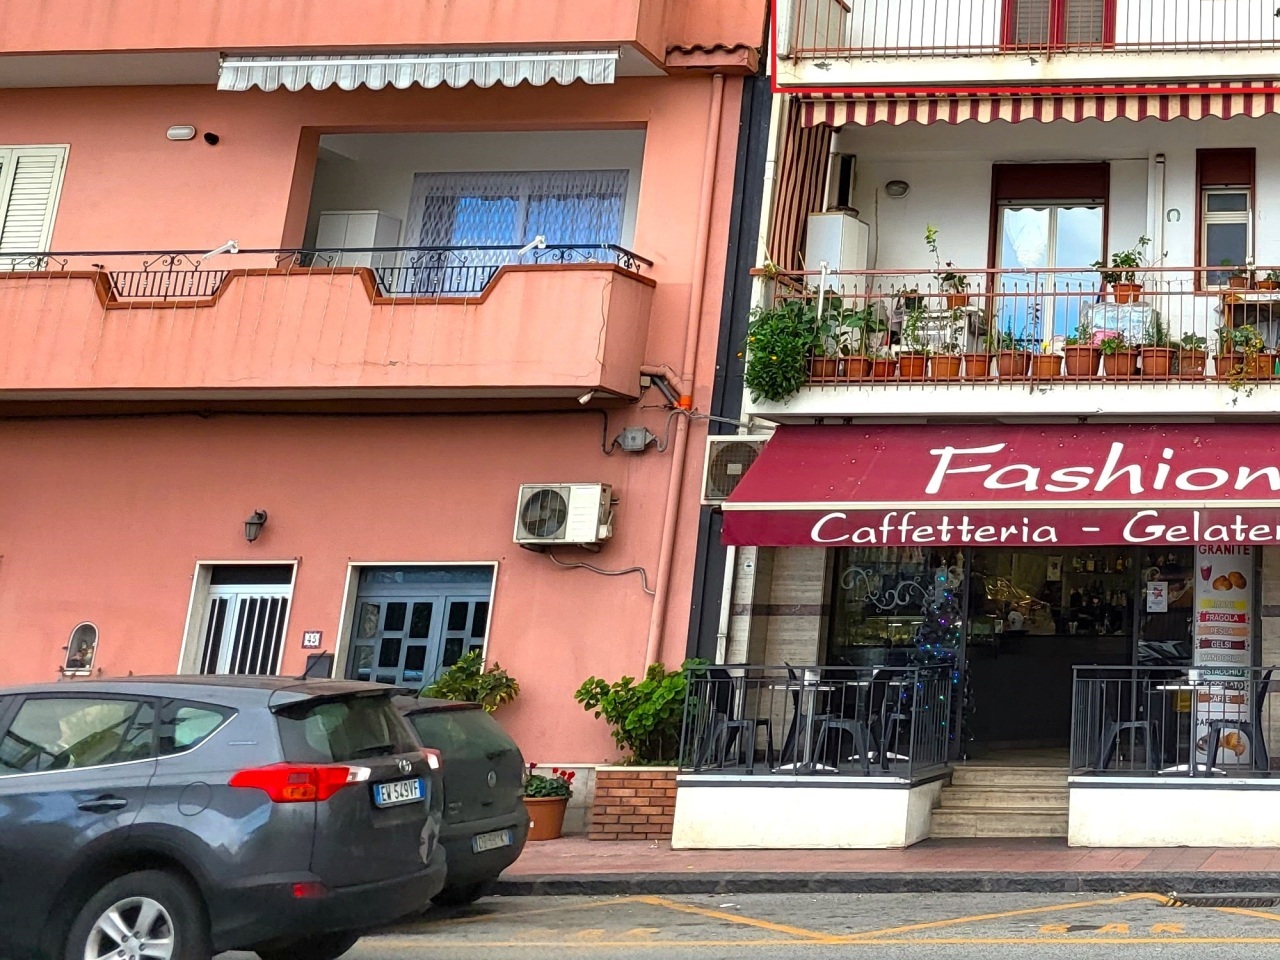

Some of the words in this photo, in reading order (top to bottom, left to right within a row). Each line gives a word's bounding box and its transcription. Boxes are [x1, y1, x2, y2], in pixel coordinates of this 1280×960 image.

[810, 510, 1058, 544] Caffetteria
[1199, 544, 1250, 555] GRANITE
[1205, 613, 1239, 622] FRAGOLA
[1210, 627, 1233, 635] PESCA
[306, 634, 317, 644] 45
[1210, 640, 1232, 649] GELSI
[381, 785, 392, 801] EW
[394, 780, 418, 800] 549VF
